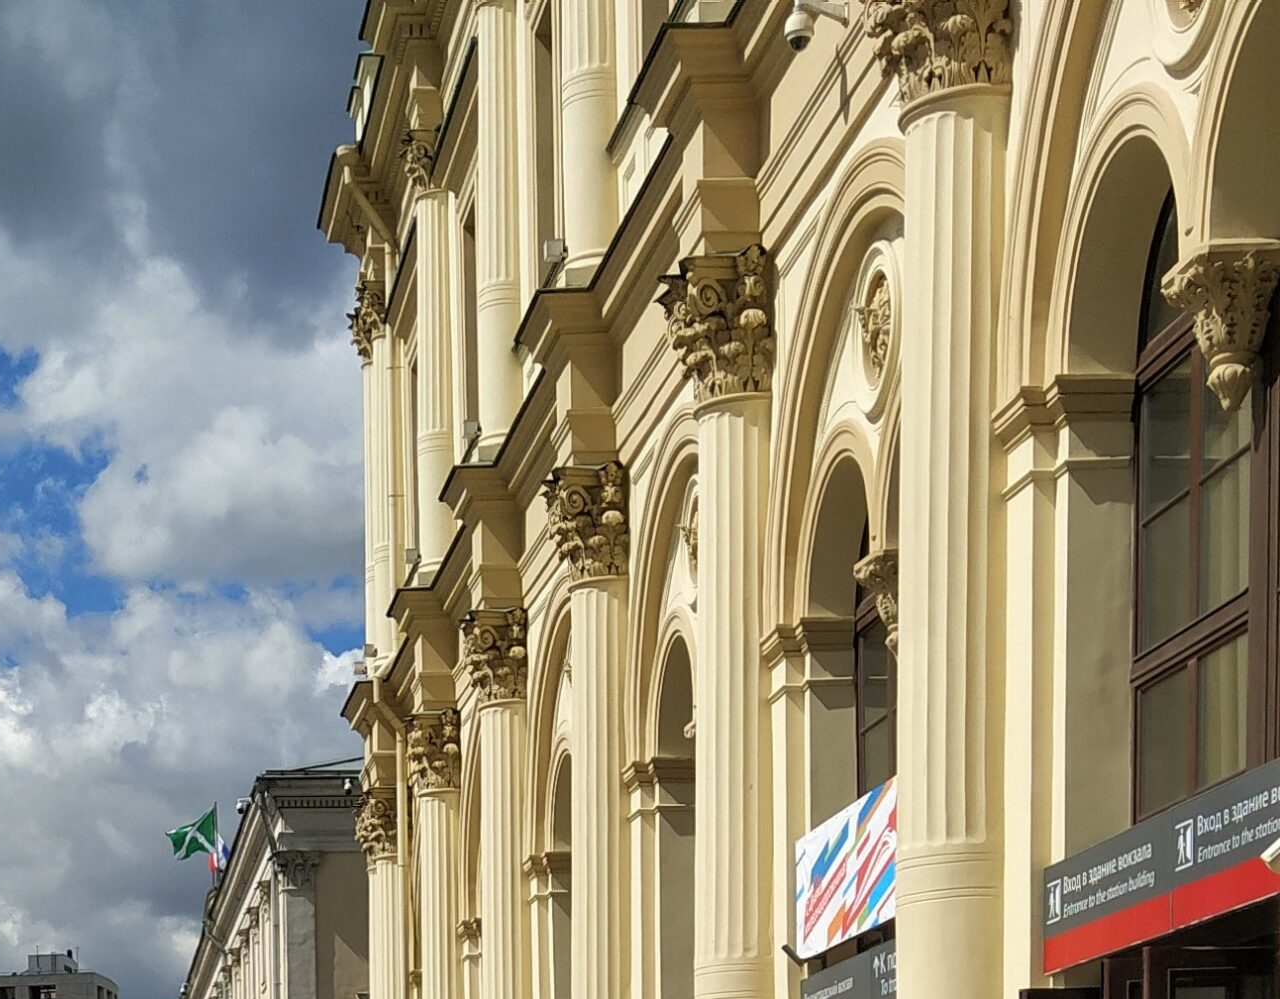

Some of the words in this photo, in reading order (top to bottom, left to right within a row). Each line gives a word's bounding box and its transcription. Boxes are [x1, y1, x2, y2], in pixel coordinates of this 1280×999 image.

[1197, 811, 1223, 837] Вход
[1223, 808, 1230, 826] в
[1231, 790, 1269, 824] здание
[1197, 839, 1231, 863] Entrance
[1231, 834, 1240, 849] to
[1241, 827, 1254, 846] the
[1063, 873, 1082, 895] Вход
[1082, 871, 1087, 886] в
[1088, 858, 1117, 886] здание
[1117, 843, 1153, 871] вокзала
[1063, 899, 1088, 919] Entrance
[1088, 894, 1096, 908] to
[1096, 888, 1107, 905] the
[1106, 881, 1128, 901] station
[1128, 870, 1155, 891] building
[879, 951, 887, 974] К
